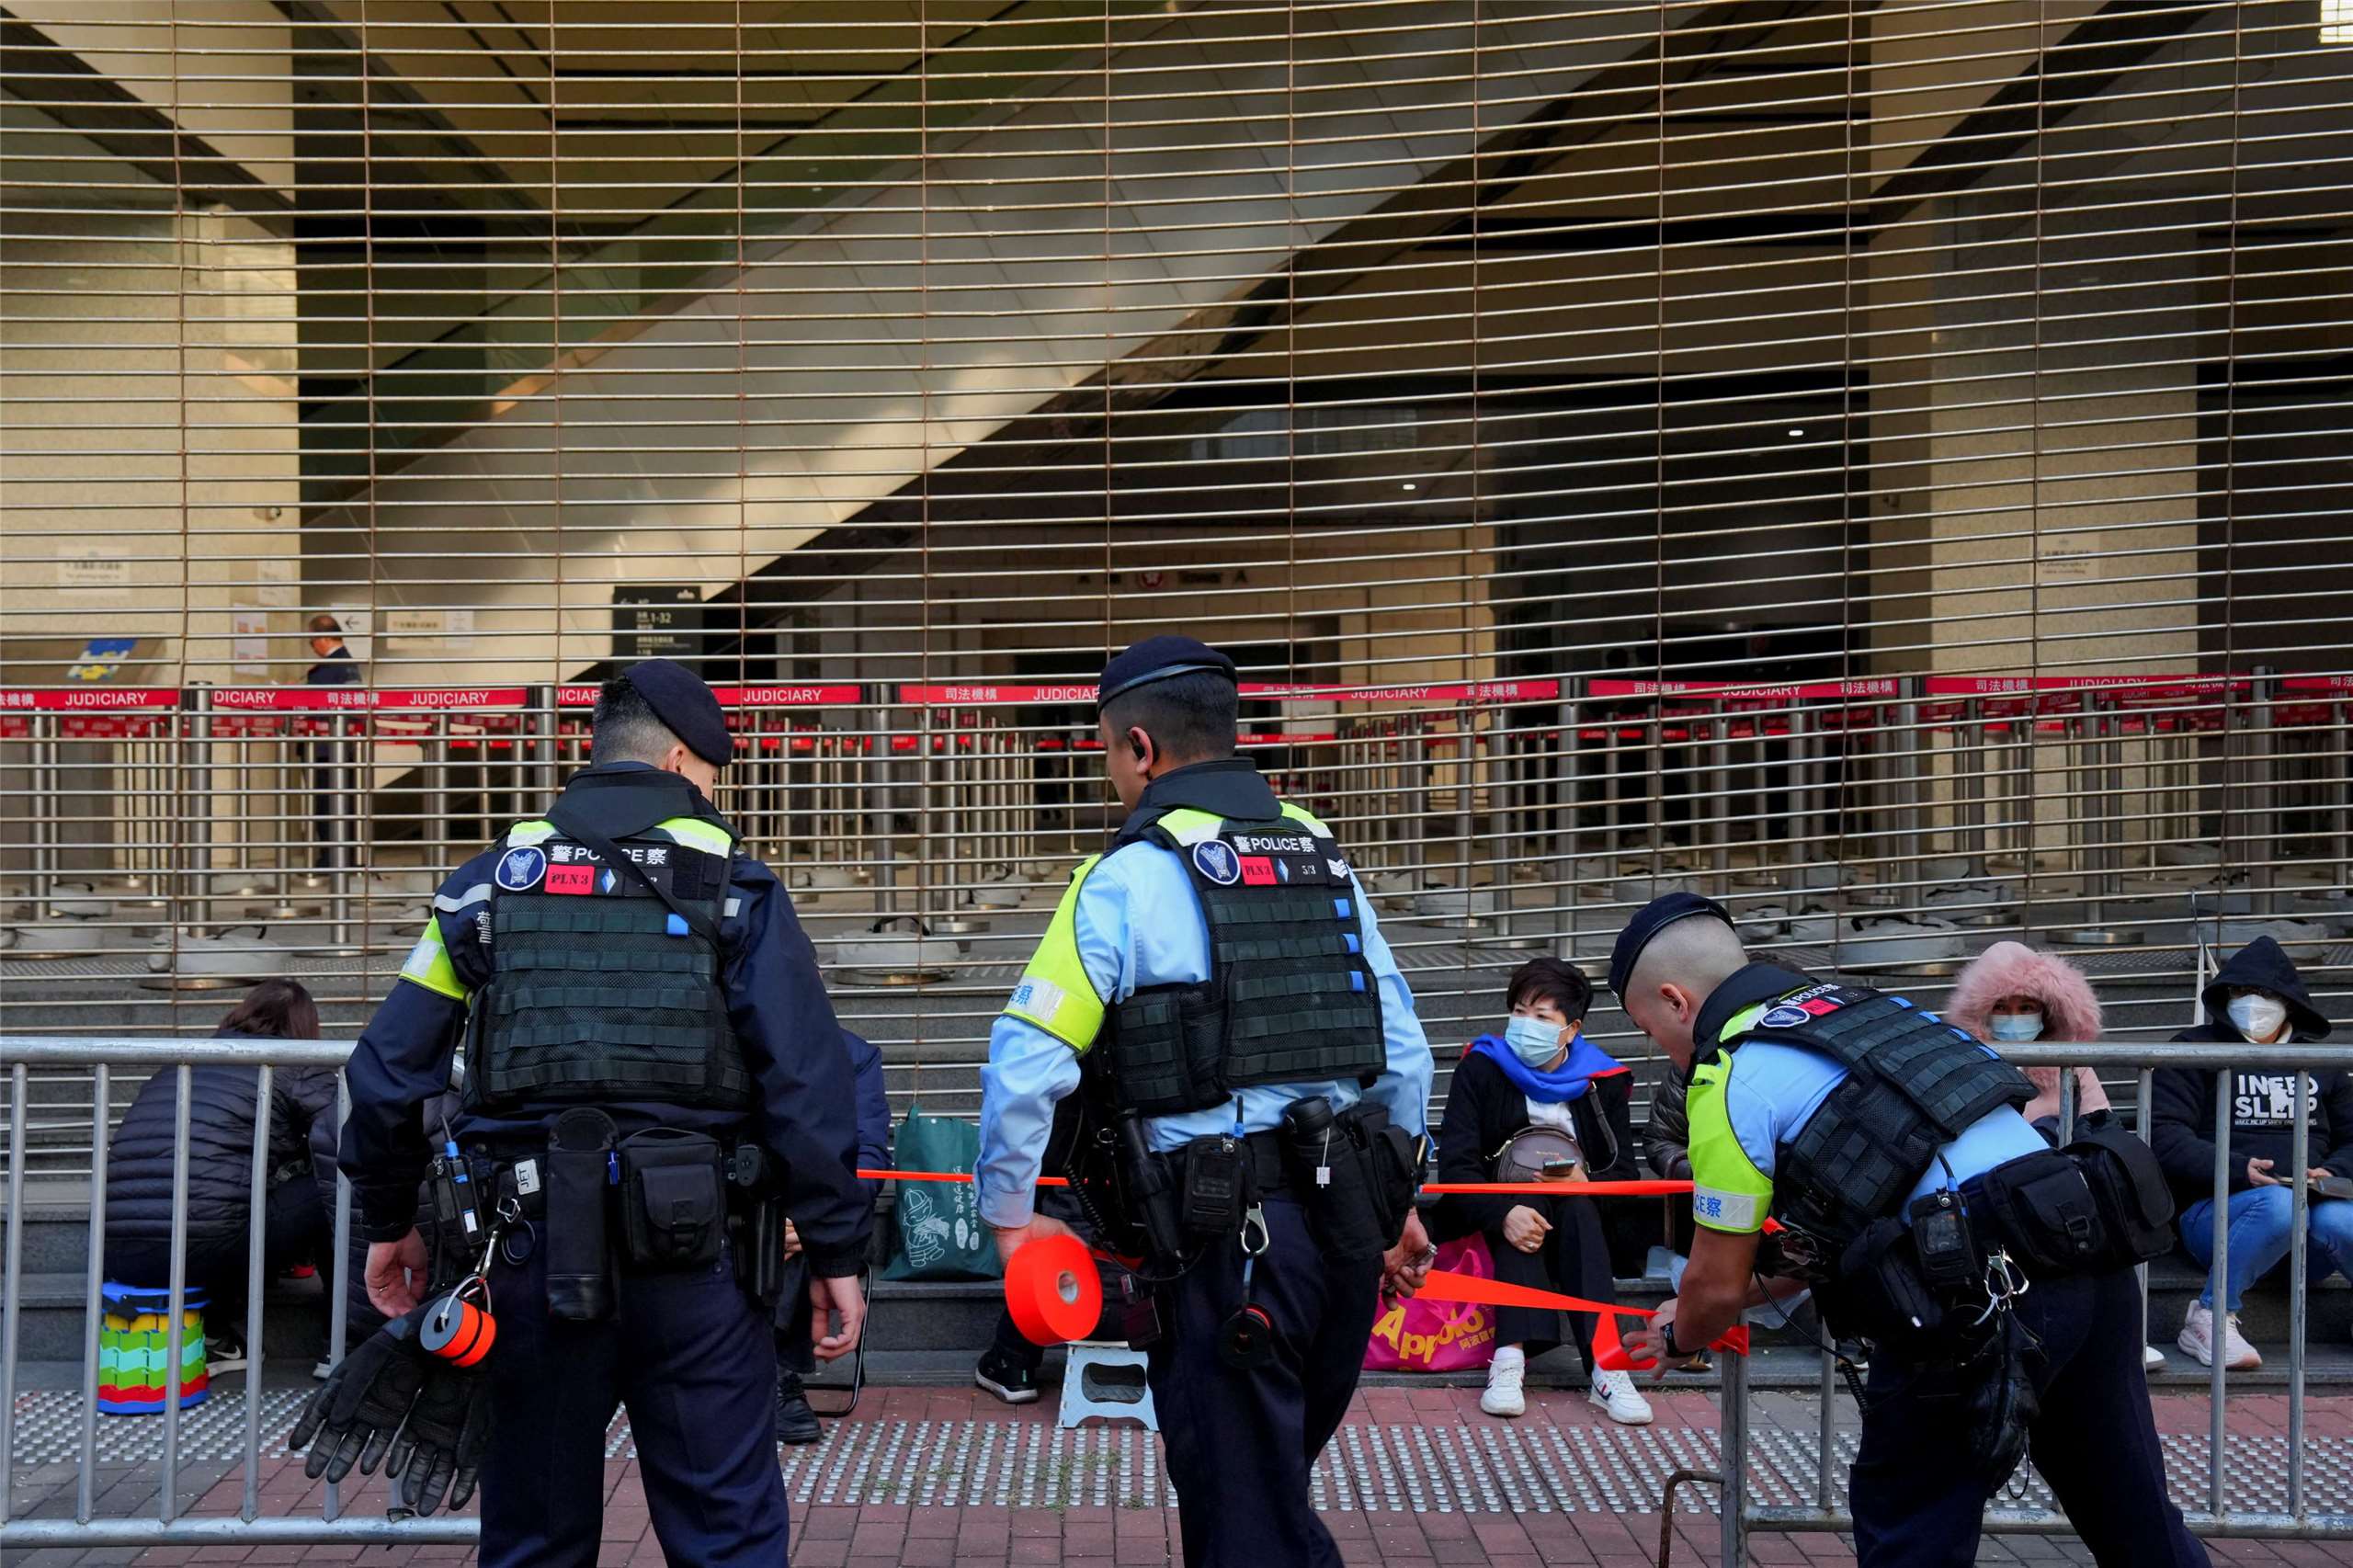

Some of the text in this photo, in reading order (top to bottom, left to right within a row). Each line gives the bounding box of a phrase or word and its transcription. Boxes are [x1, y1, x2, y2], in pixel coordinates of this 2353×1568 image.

[743, 687, 823, 702] JUDICIARY
[945, 687, 997, 701] 司法機構
[1466, 684, 1518, 698] 司法機構
[1840, 680, 1893, 694] 司法機構
[65, 692, 147, 707] JUDICIARY
[213, 690, 489, 706] DICIARY 司法機構 JUDICIARY
[1233, 836, 1316, 853] 警 POLICE 察
[551, 845, 574, 862] 警
[646, 848, 667, 865] 察
[1301, 864, 1316, 875] 5/3
[551, 873, 589, 885] PLN 3
[2237, 1074, 2246, 1096] I
[1706, 1197, 1722, 1218] 察
